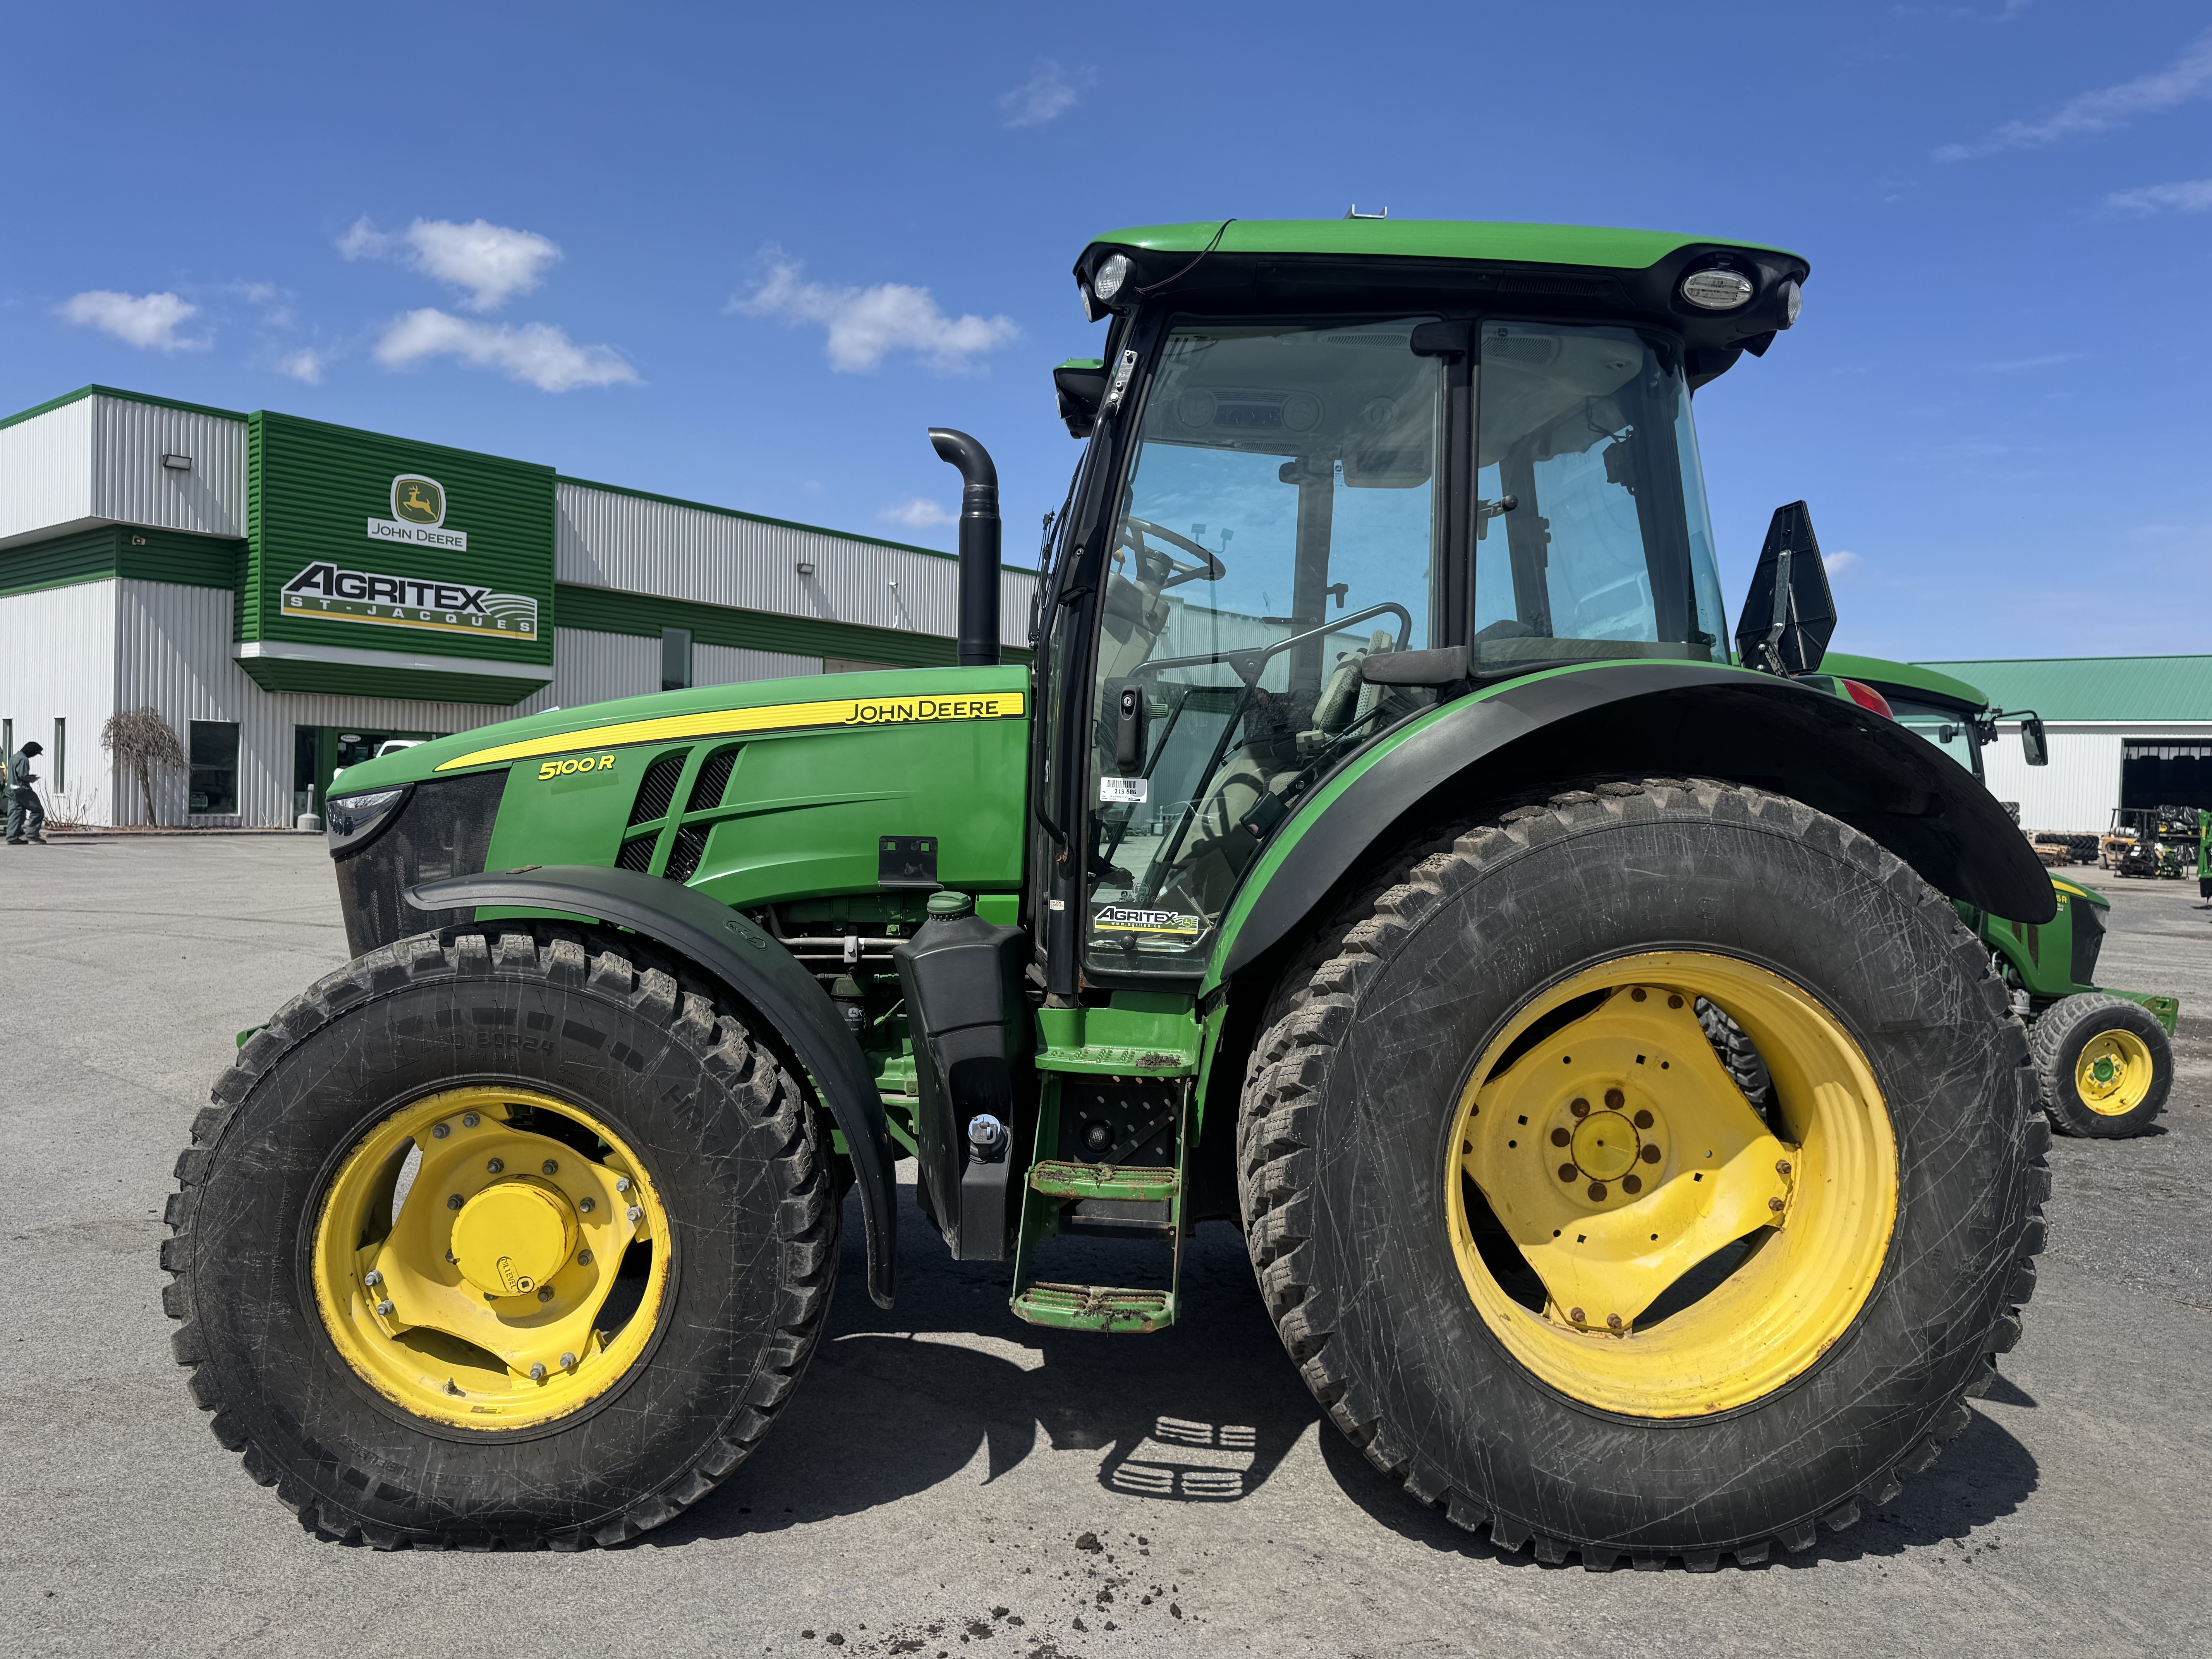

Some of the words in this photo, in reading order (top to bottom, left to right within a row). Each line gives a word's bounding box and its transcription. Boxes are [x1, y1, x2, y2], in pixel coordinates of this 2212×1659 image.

[372, 523, 412, 539] JOHN
[417, 529, 463, 547] DEERE
[285, 565, 488, 613] AGRITEX
[846, 703, 914, 722] JOHN
[919, 700, 999, 718] DEERE
[1097, 908, 1176, 925] AGRITEX
